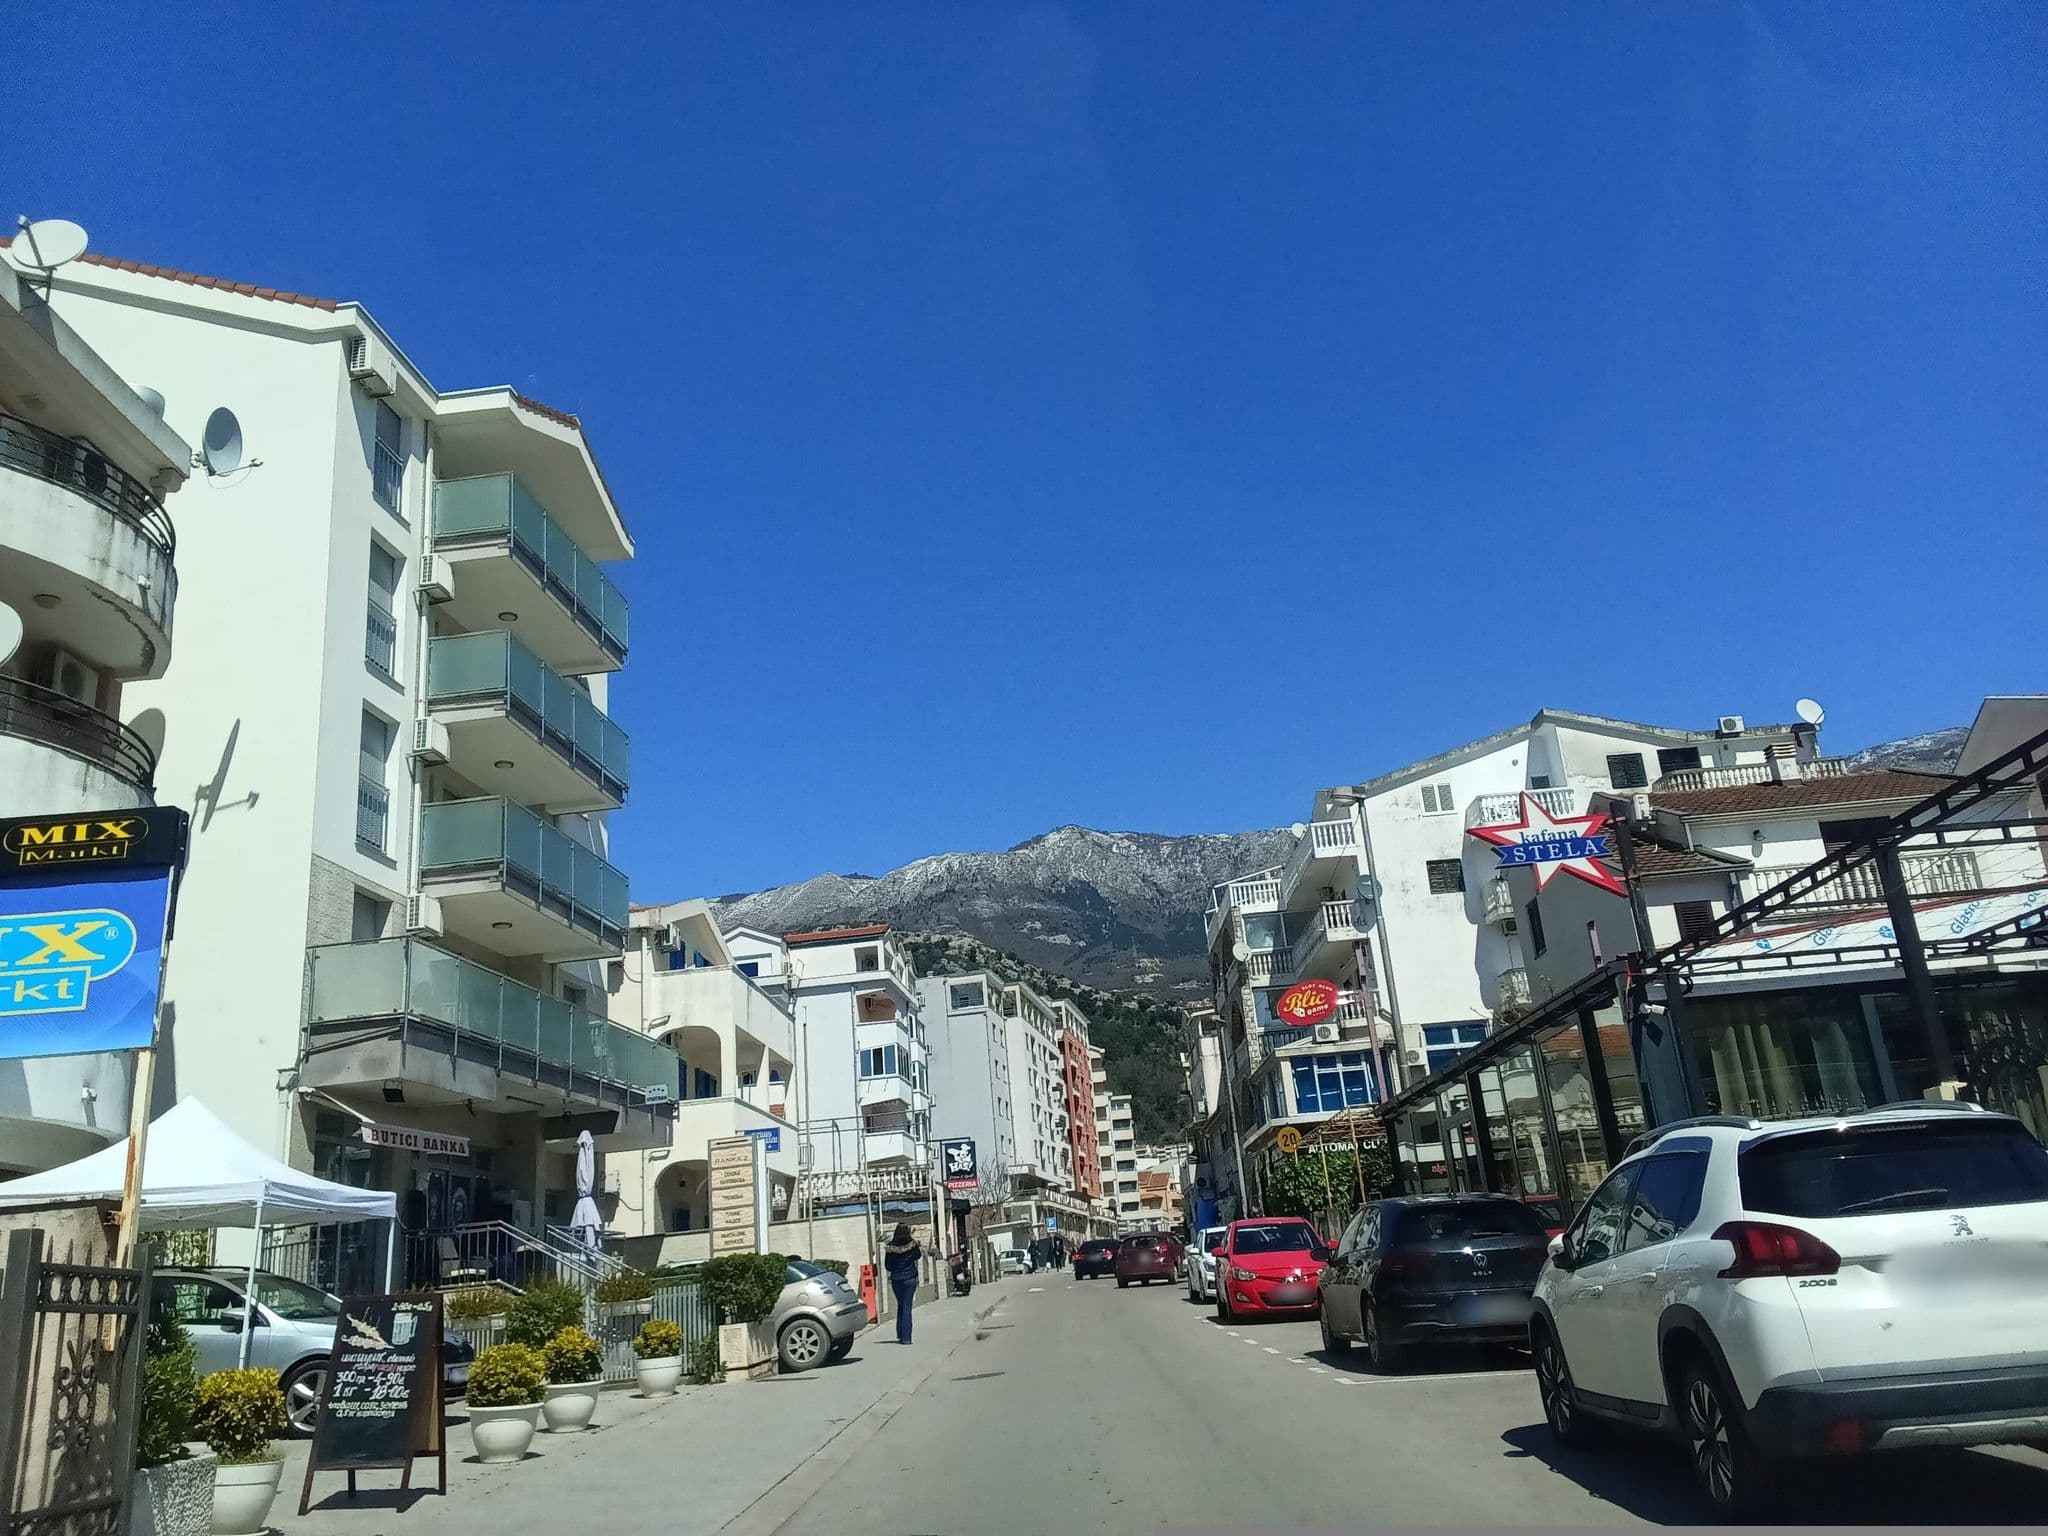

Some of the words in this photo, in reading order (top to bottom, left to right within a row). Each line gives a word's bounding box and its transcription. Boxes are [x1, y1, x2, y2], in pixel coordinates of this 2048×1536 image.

[19, 819, 135, 846] MIX
[1519, 829, 1578, 844] kafana
[1514, 839, 1599, 863] STELA
[1283, 989, 1326, 1012] Blic
[1306, 1003, 1329, 1016] game
[371, 1129, 418, 1148] BUTICI
[423, 1138, 466, 1153] BANKA
[1282, 1132, 1297, 1147] 20
[947, 1180, 977, 1188] PIZZERIA
